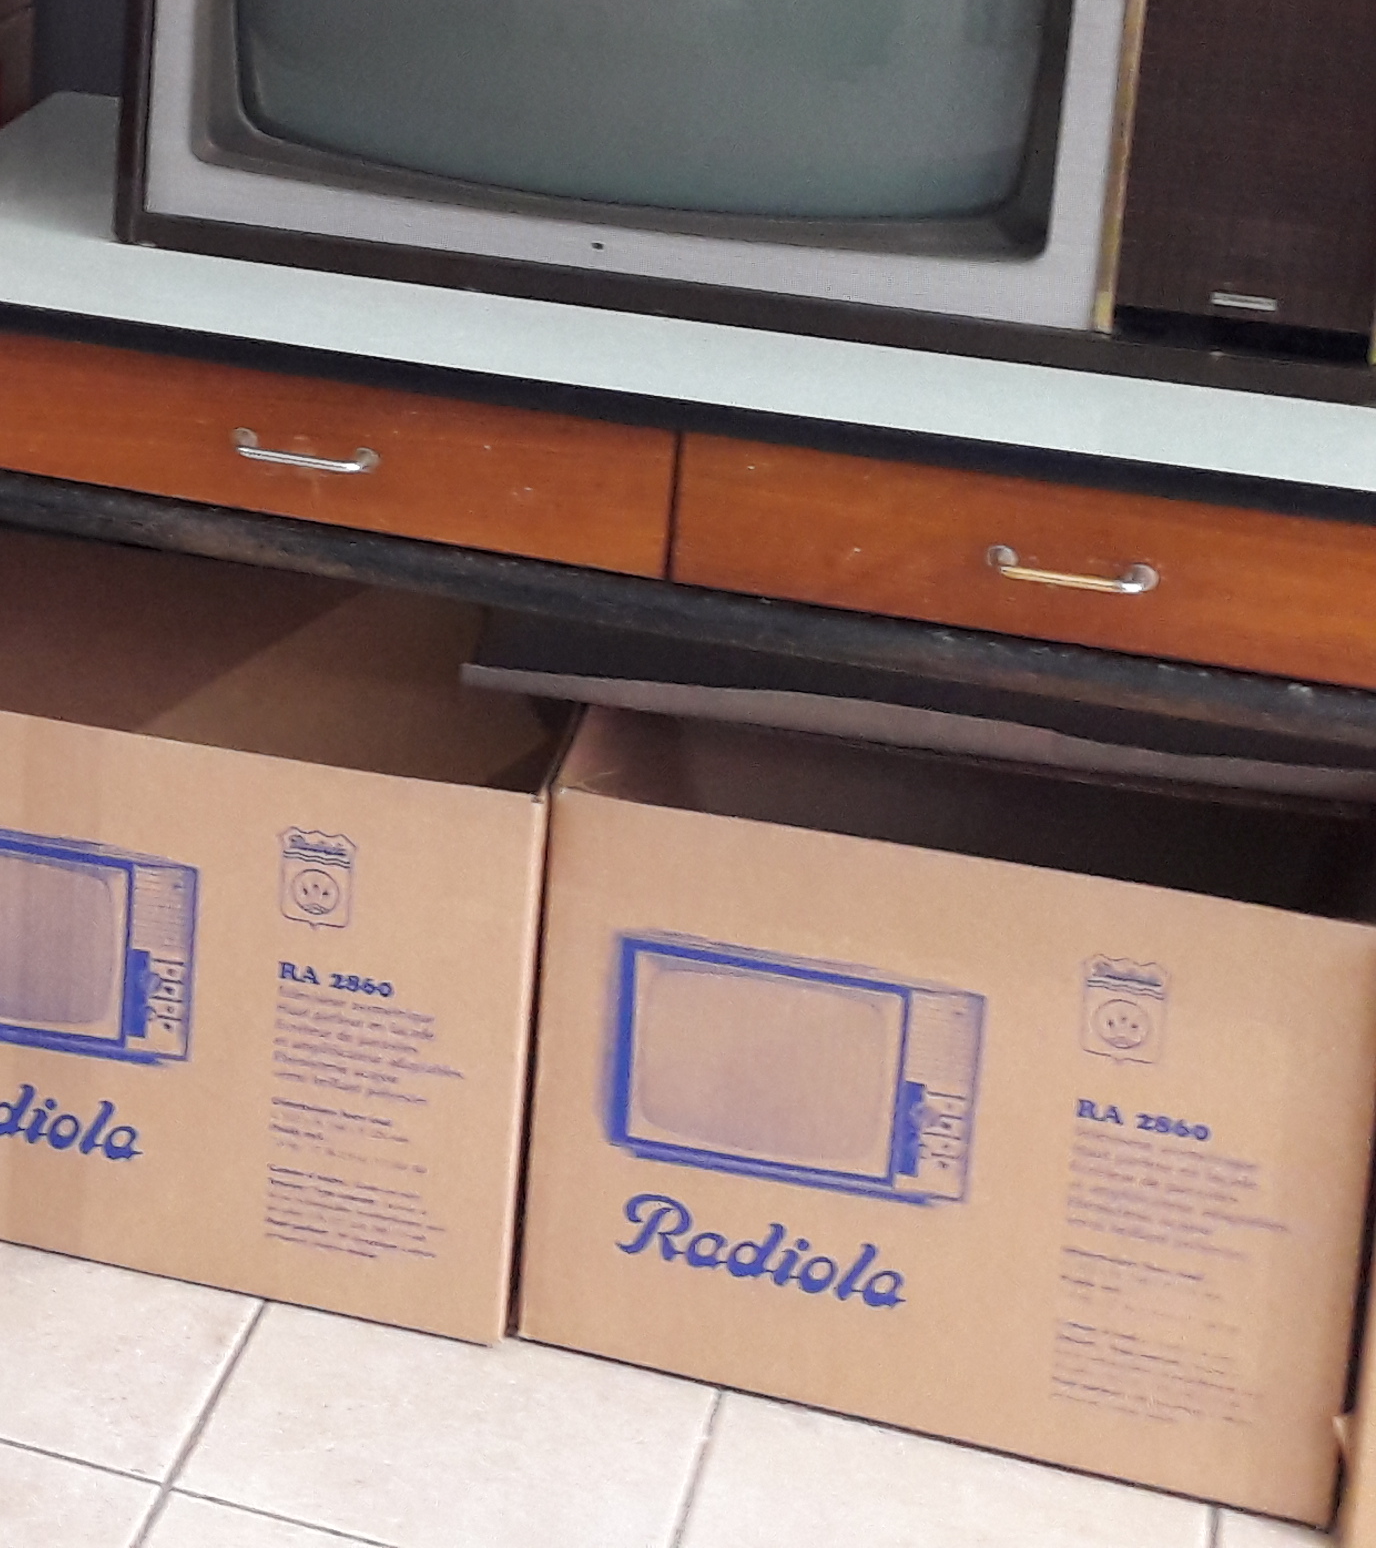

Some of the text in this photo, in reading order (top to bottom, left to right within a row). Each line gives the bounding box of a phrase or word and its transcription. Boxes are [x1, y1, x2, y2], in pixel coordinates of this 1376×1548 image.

[278, 960, 321, 985] RA
[1076, 1098, 1212, 1141] RA 2860
[615, 1193, 907, 1310] Radiola
